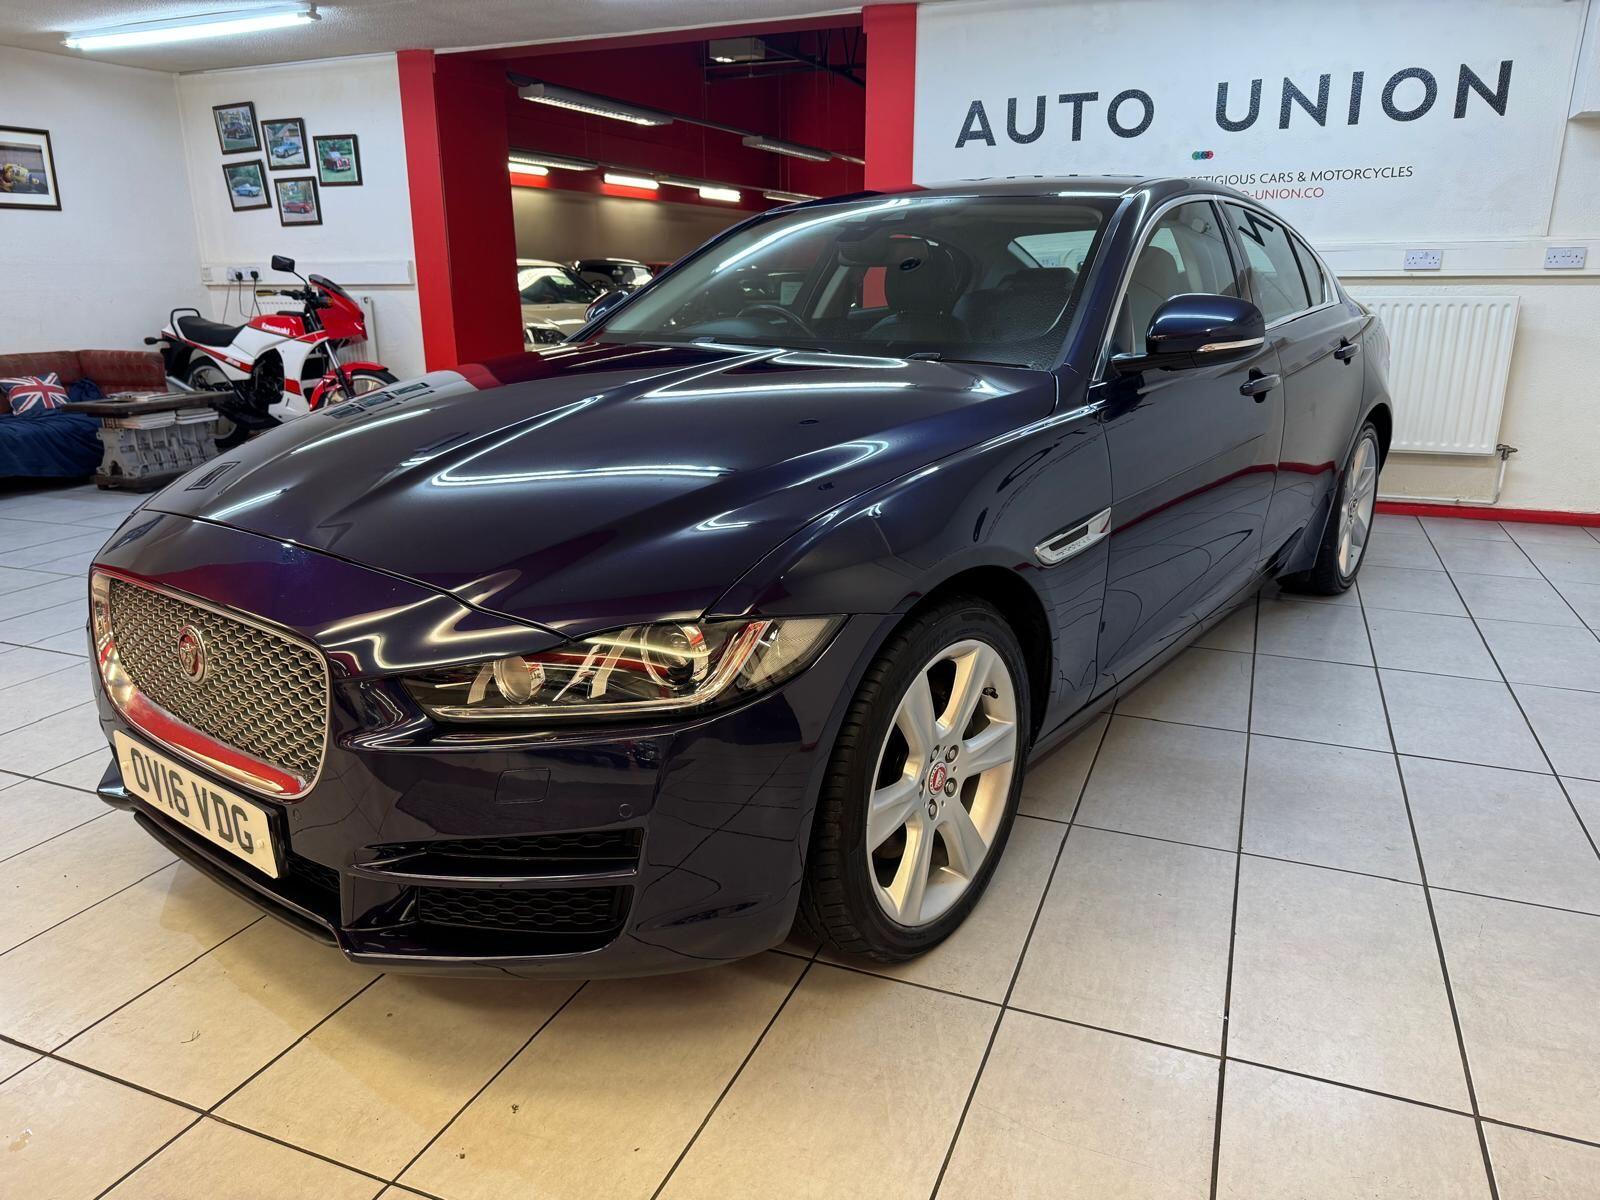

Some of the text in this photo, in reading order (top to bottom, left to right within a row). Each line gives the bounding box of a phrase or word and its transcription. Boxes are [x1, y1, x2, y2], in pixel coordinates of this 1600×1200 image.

[955, 60, 1513, 149] AUTO UNION
[1184, 166, 1413, 186] TIGIOUS CARS & MOTORCYCLES
[1241, 187, 1324, 200] -UNION.CO
[131, 747, 254, 855] OV16 VDG
